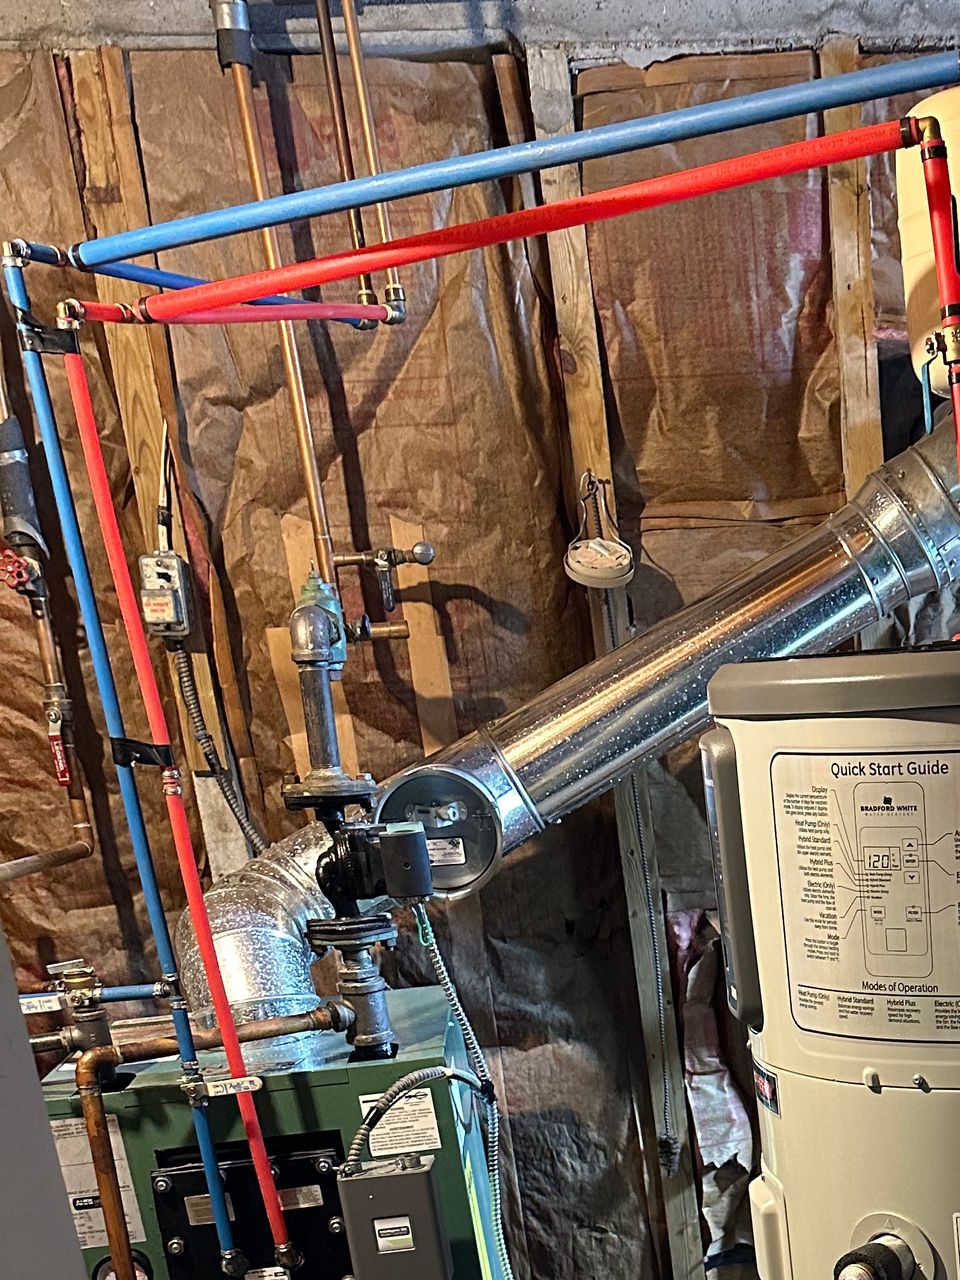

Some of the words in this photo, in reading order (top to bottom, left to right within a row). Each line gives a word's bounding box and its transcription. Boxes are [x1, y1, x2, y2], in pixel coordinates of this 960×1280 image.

[831, 762, 866, 778] Quick
[869, 762, 904, 776] Start
[907, 760, 949, 775] Guide
[812, 786, 828, 794] Display
[869, 855, 889, 868] 120
[862, 981, 887, 991] Modes
[888, 982, 897, 991] of
[898, 982, 938, 993] Operation
[837, 995, 852, 1003] Hybrid
[852, 996, 874, 1004] Standard
